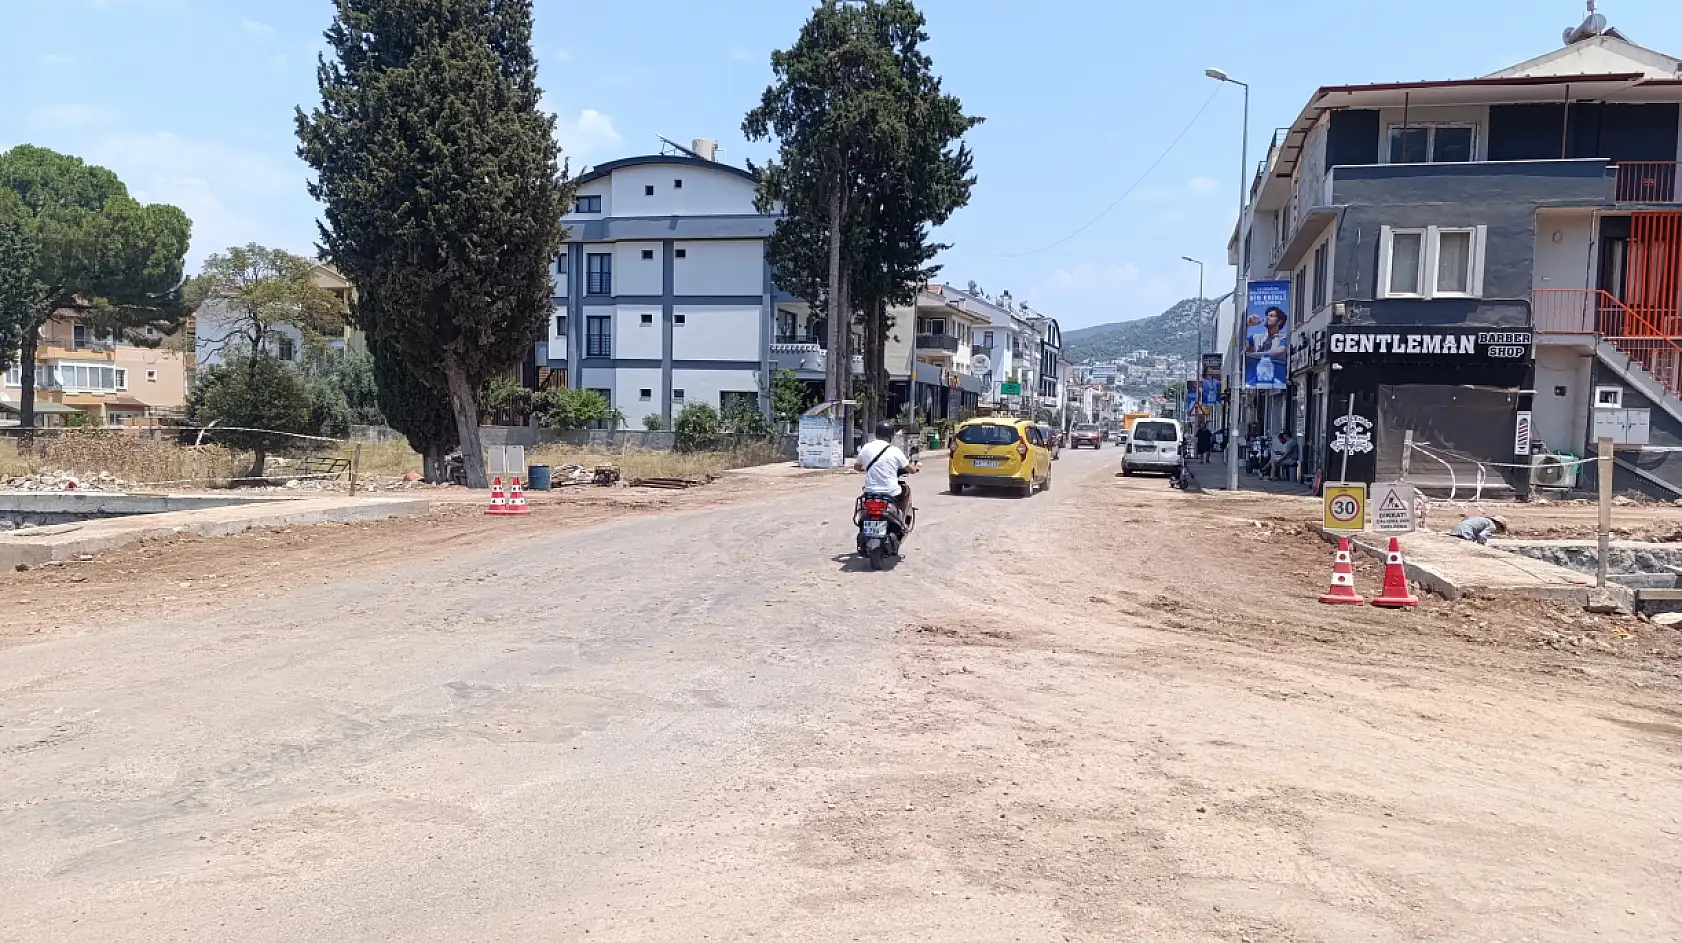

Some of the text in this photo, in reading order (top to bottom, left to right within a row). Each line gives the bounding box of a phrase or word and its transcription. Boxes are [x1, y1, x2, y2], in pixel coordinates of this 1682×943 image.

[1330, 333, 1476, 354] GENTLEMAN
[1478, 332, 1532, 344] BARBER
[1487, 345, 1525, 357] SHOP
[1333, 501, 1355, 515] 30
